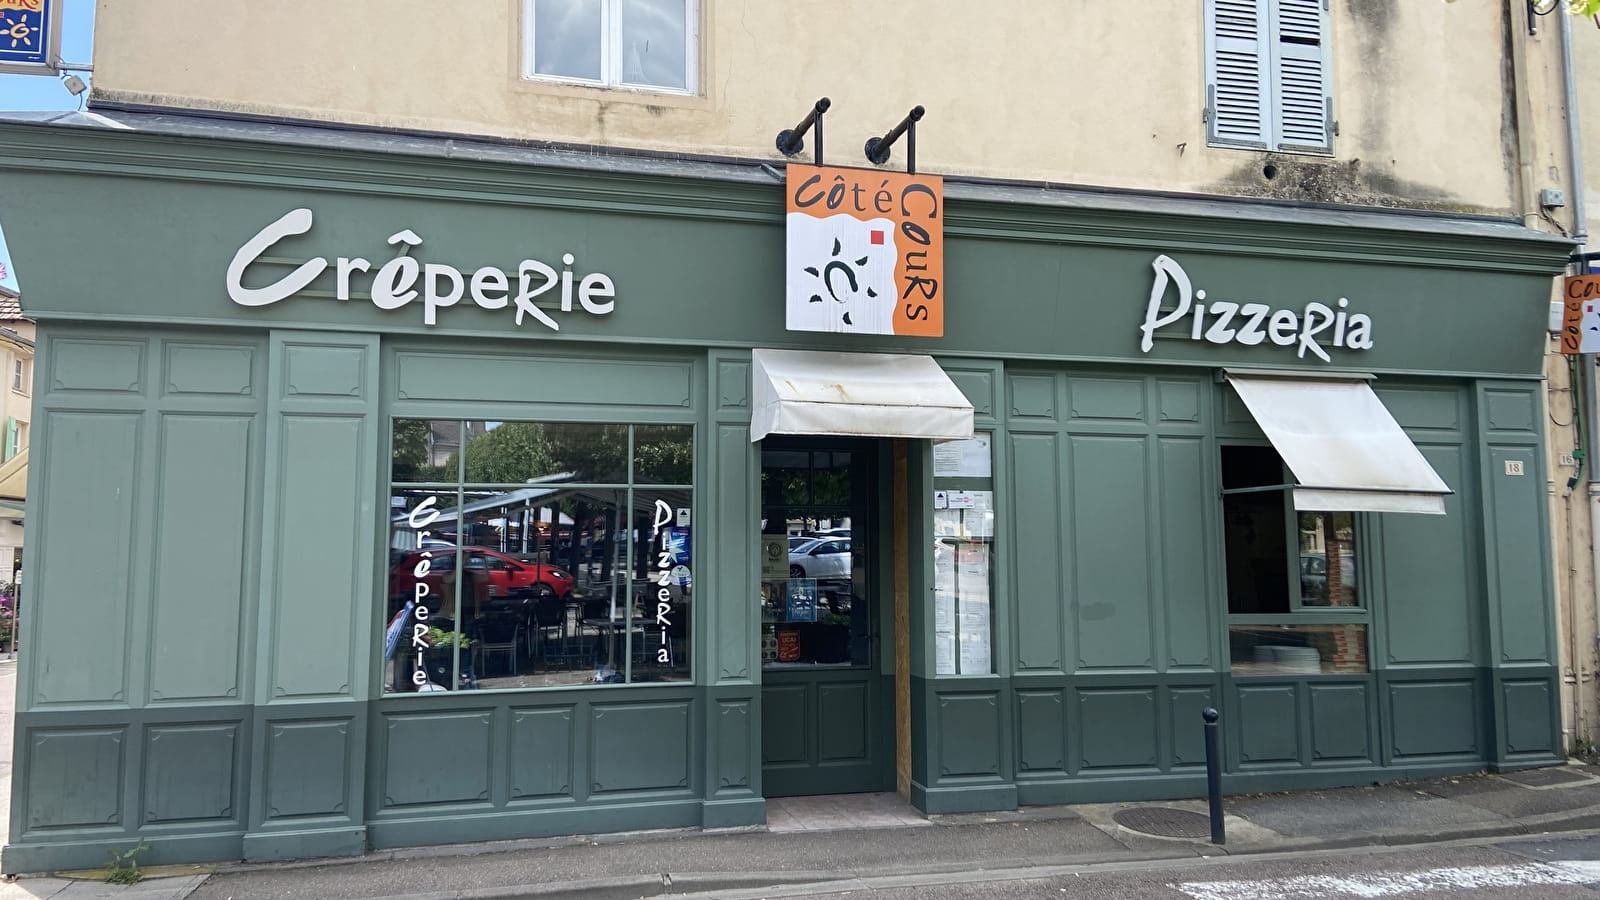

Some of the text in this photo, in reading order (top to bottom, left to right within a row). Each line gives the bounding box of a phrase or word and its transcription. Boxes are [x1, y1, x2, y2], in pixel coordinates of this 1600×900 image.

[794, 174, 893, 213] Côté
[1561, 455, 1573, 464] 16
[1508, 463, 1520, 473] 18
